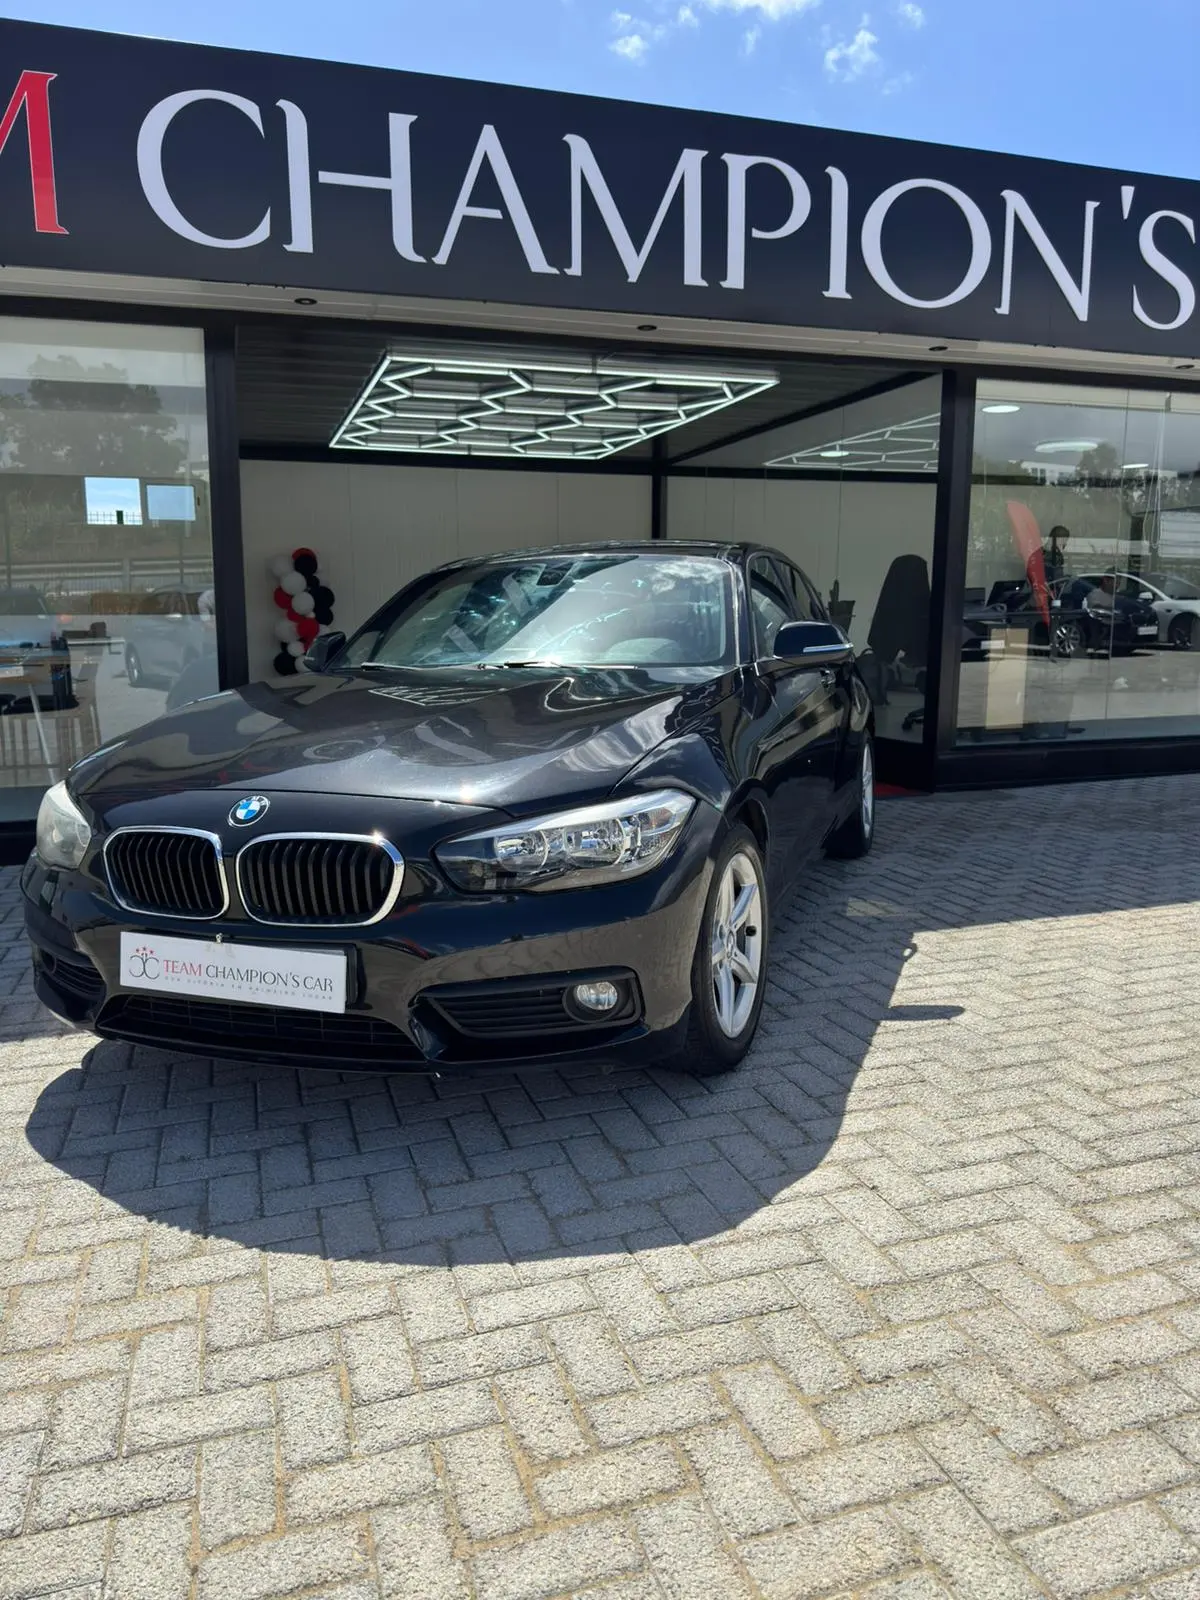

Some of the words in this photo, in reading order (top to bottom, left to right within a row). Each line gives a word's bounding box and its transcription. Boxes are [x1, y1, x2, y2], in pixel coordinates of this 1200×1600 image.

[136, 89, 1196, 331] CHAMPION'S
[163, 959, 202, 977] TEAM
[205, 964, 300, 989] CHAMPION'S
[303, 975, 333, 993] CAR
